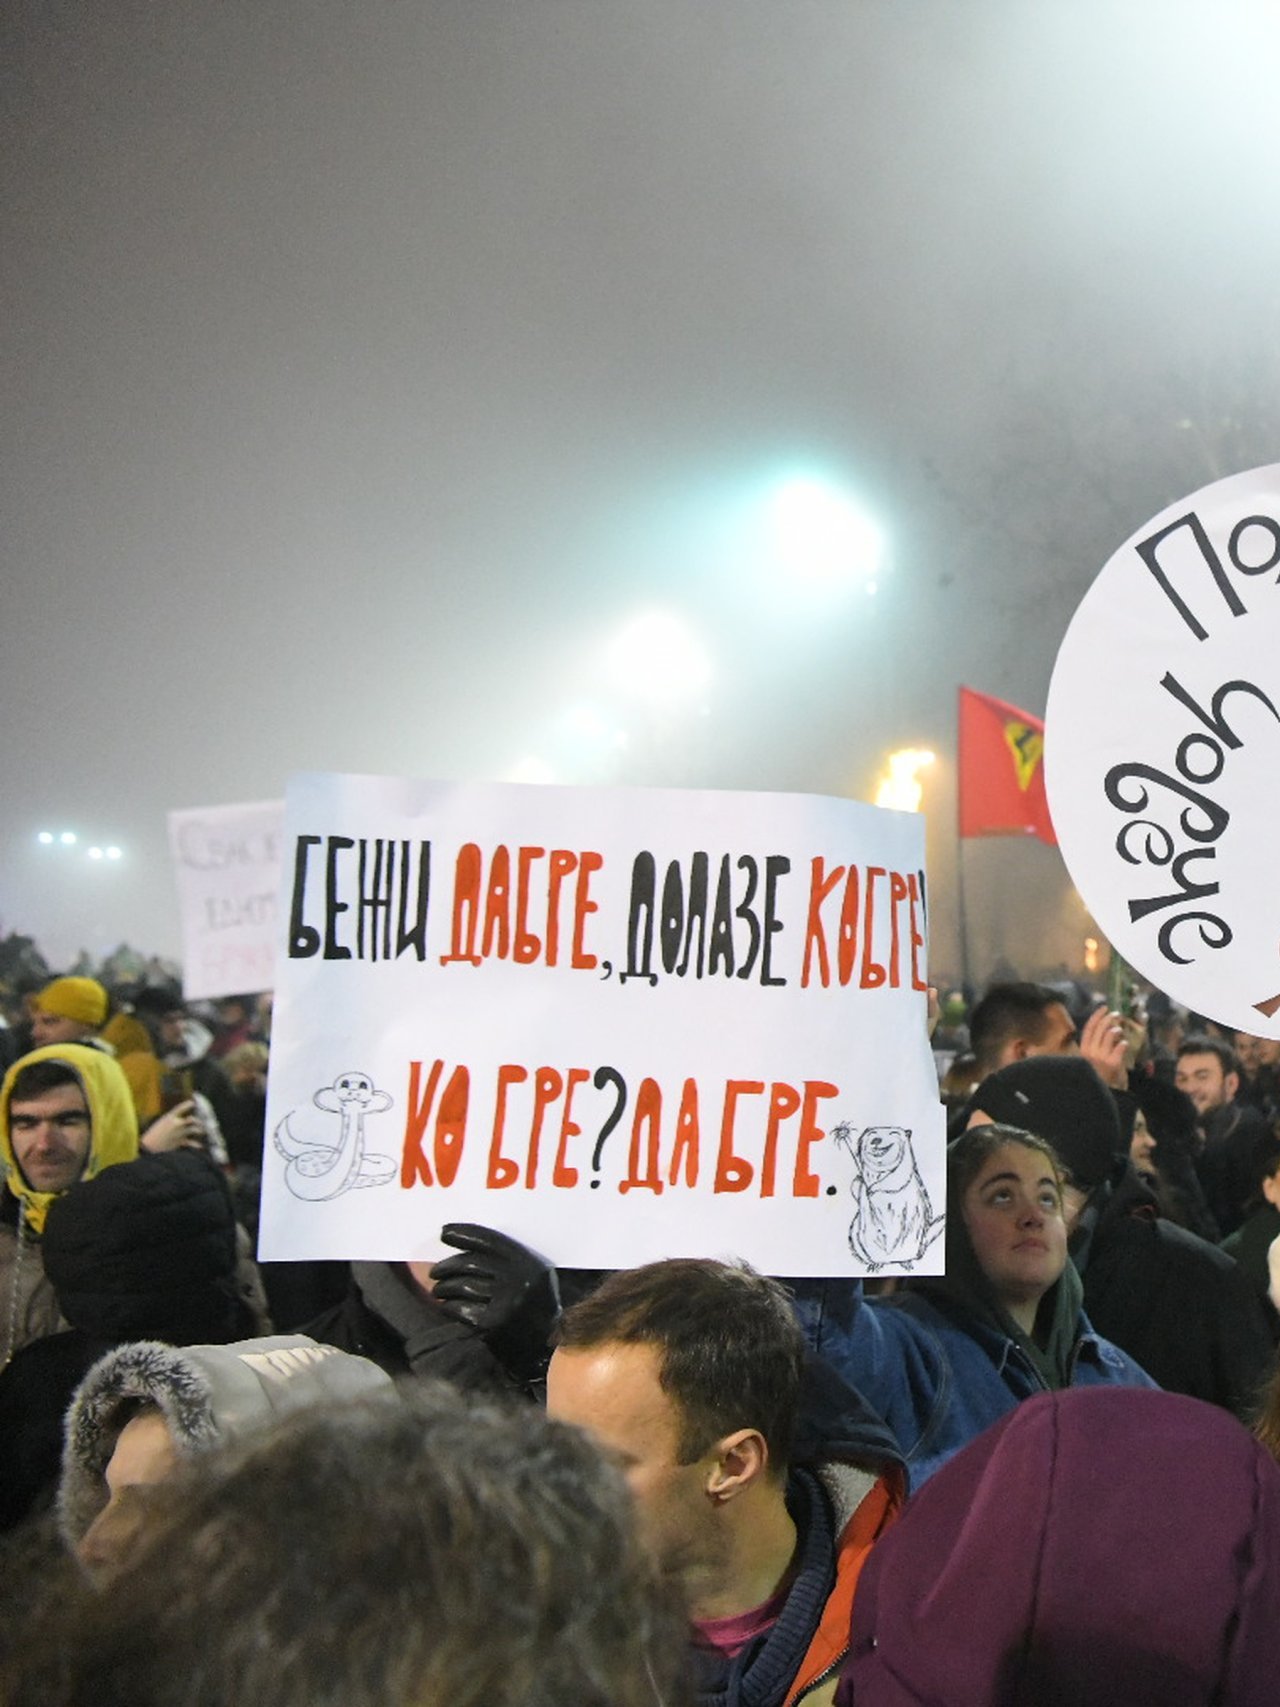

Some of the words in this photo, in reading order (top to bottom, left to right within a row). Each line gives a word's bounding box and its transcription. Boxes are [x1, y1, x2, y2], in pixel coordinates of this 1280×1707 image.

[288, 835, 431, 962] БЕЖИ
[440, 842, 614, 982] ДАБРЕ,
[618, 850, 791, 987] ДОЛАЗЕ
[400, 1059, 471, 1191] КО
[485, 1065, 627, 1192] БРЕ?
[618, 1076, 700, 1196] ДА
[713, 1079, 840, 1198] БРЕ.
